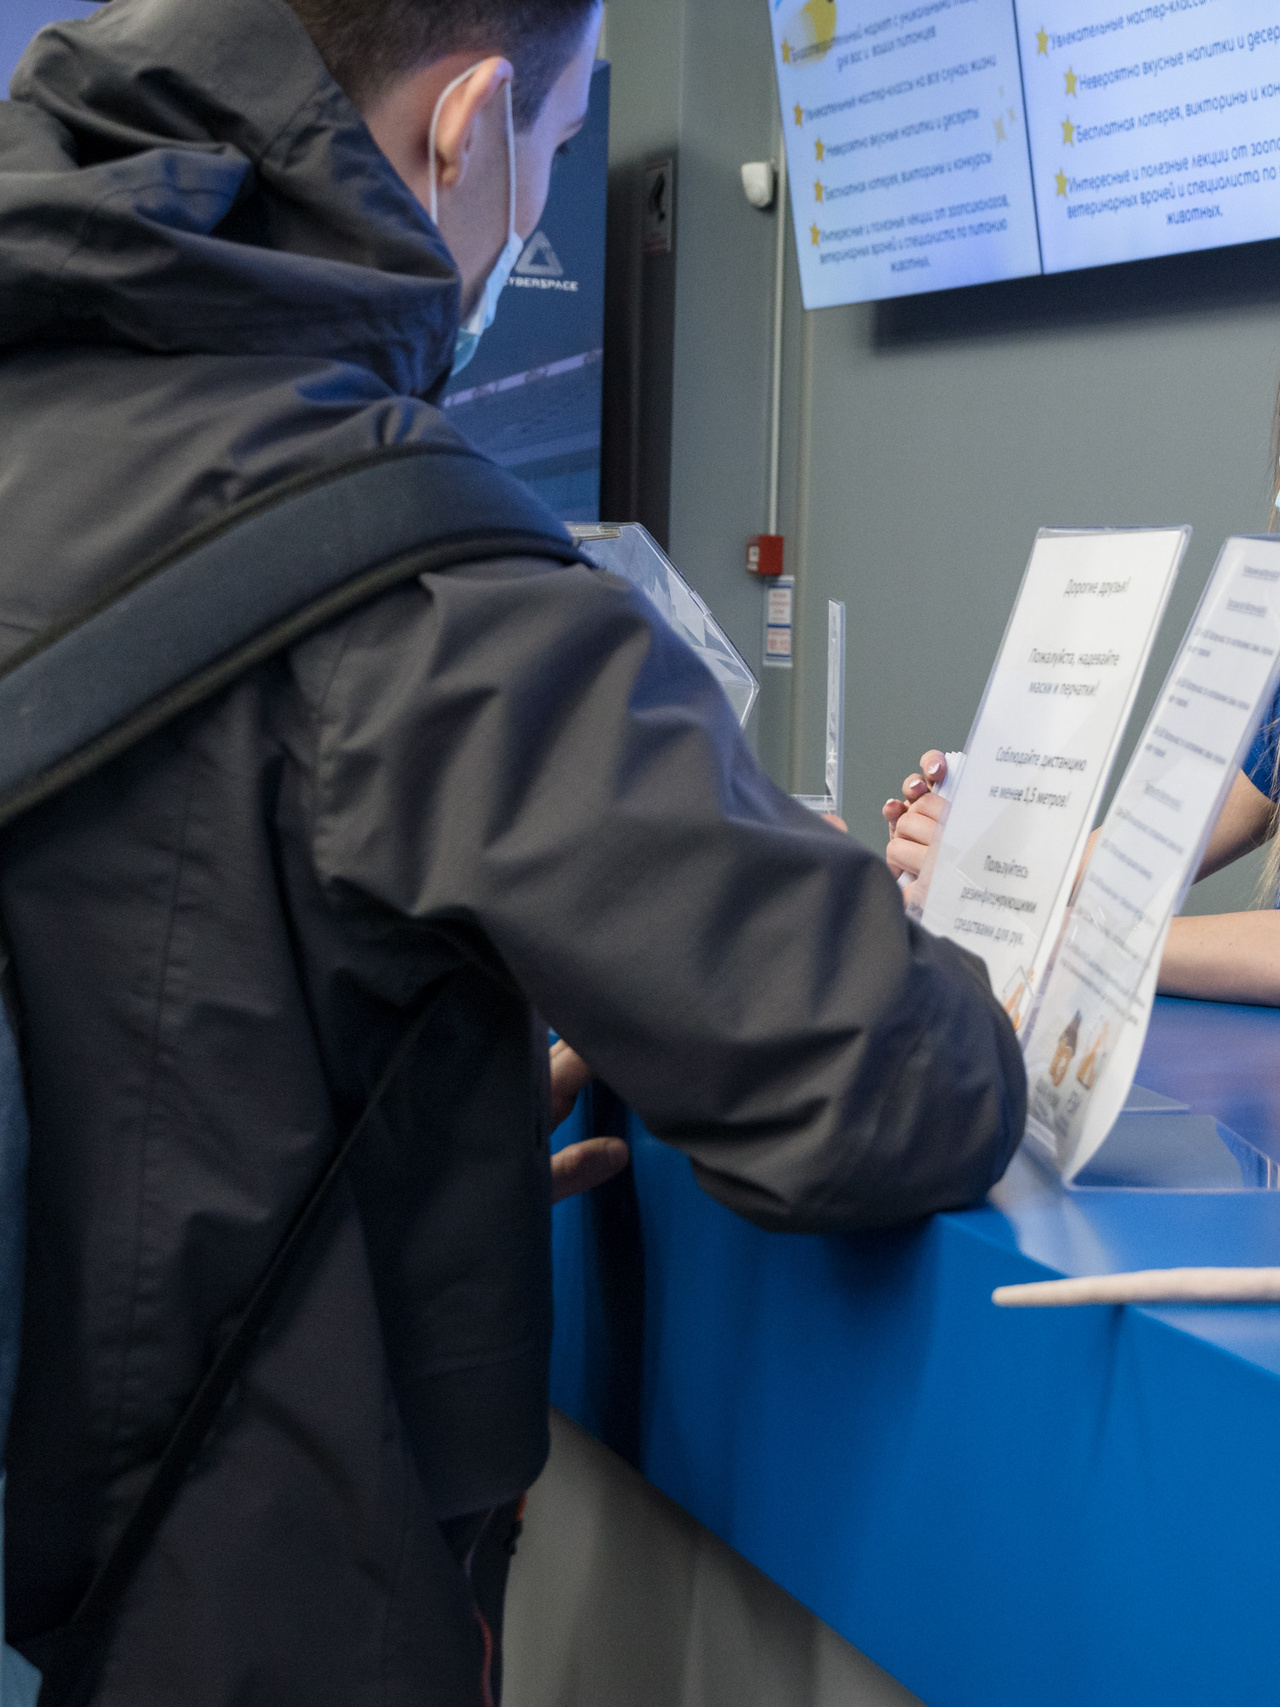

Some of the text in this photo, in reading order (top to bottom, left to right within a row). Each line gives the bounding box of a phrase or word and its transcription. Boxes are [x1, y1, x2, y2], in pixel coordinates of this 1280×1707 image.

[1050, 16, 1124, 49] Увлекательные
[1079, 64, 1140, 91] Невероятно
[1142, 51, 1184, 77] вкусные
[1186, 38, 1235, 63] напитки
[1237, 36, 1245, 49] и
[1076, 117, 1135, 143] Бесплатная
[1138, 106, 1185, 127] лотерея,
[1185, 91, 1248, 118] викторины
[1250, 88, 1258, 101] и
[1068, 171, 1130, 194] Интересные
[1132, 169, 1139, 181] и
[1141, 157, 1189, 178] полезные
[1191, 150, 1229, 169] лекции
[1231, 145, 1248, 160] от
[1067, 194, 1138, 219] ветеринарных
[1140, 181, 1176, 207] врачей
[1177, 185, 1185, 198] и
[1187, 170, 1260, 196] специалиста
[1262, 166, 1277, 181] по
[1166, 204, 1223, 225] животных.
[1063, 576, 1132, 597] Дорогие друзья!
[1028, 648, 1121, 668] Пожалуйста, надевайте
[1028, 681, 1052, 694] маски
[995, 746, 1088, 772] Соблюдайте дистанцию
[988, 785, 999, 798] не
[999, 786, 1023, 801] менее
